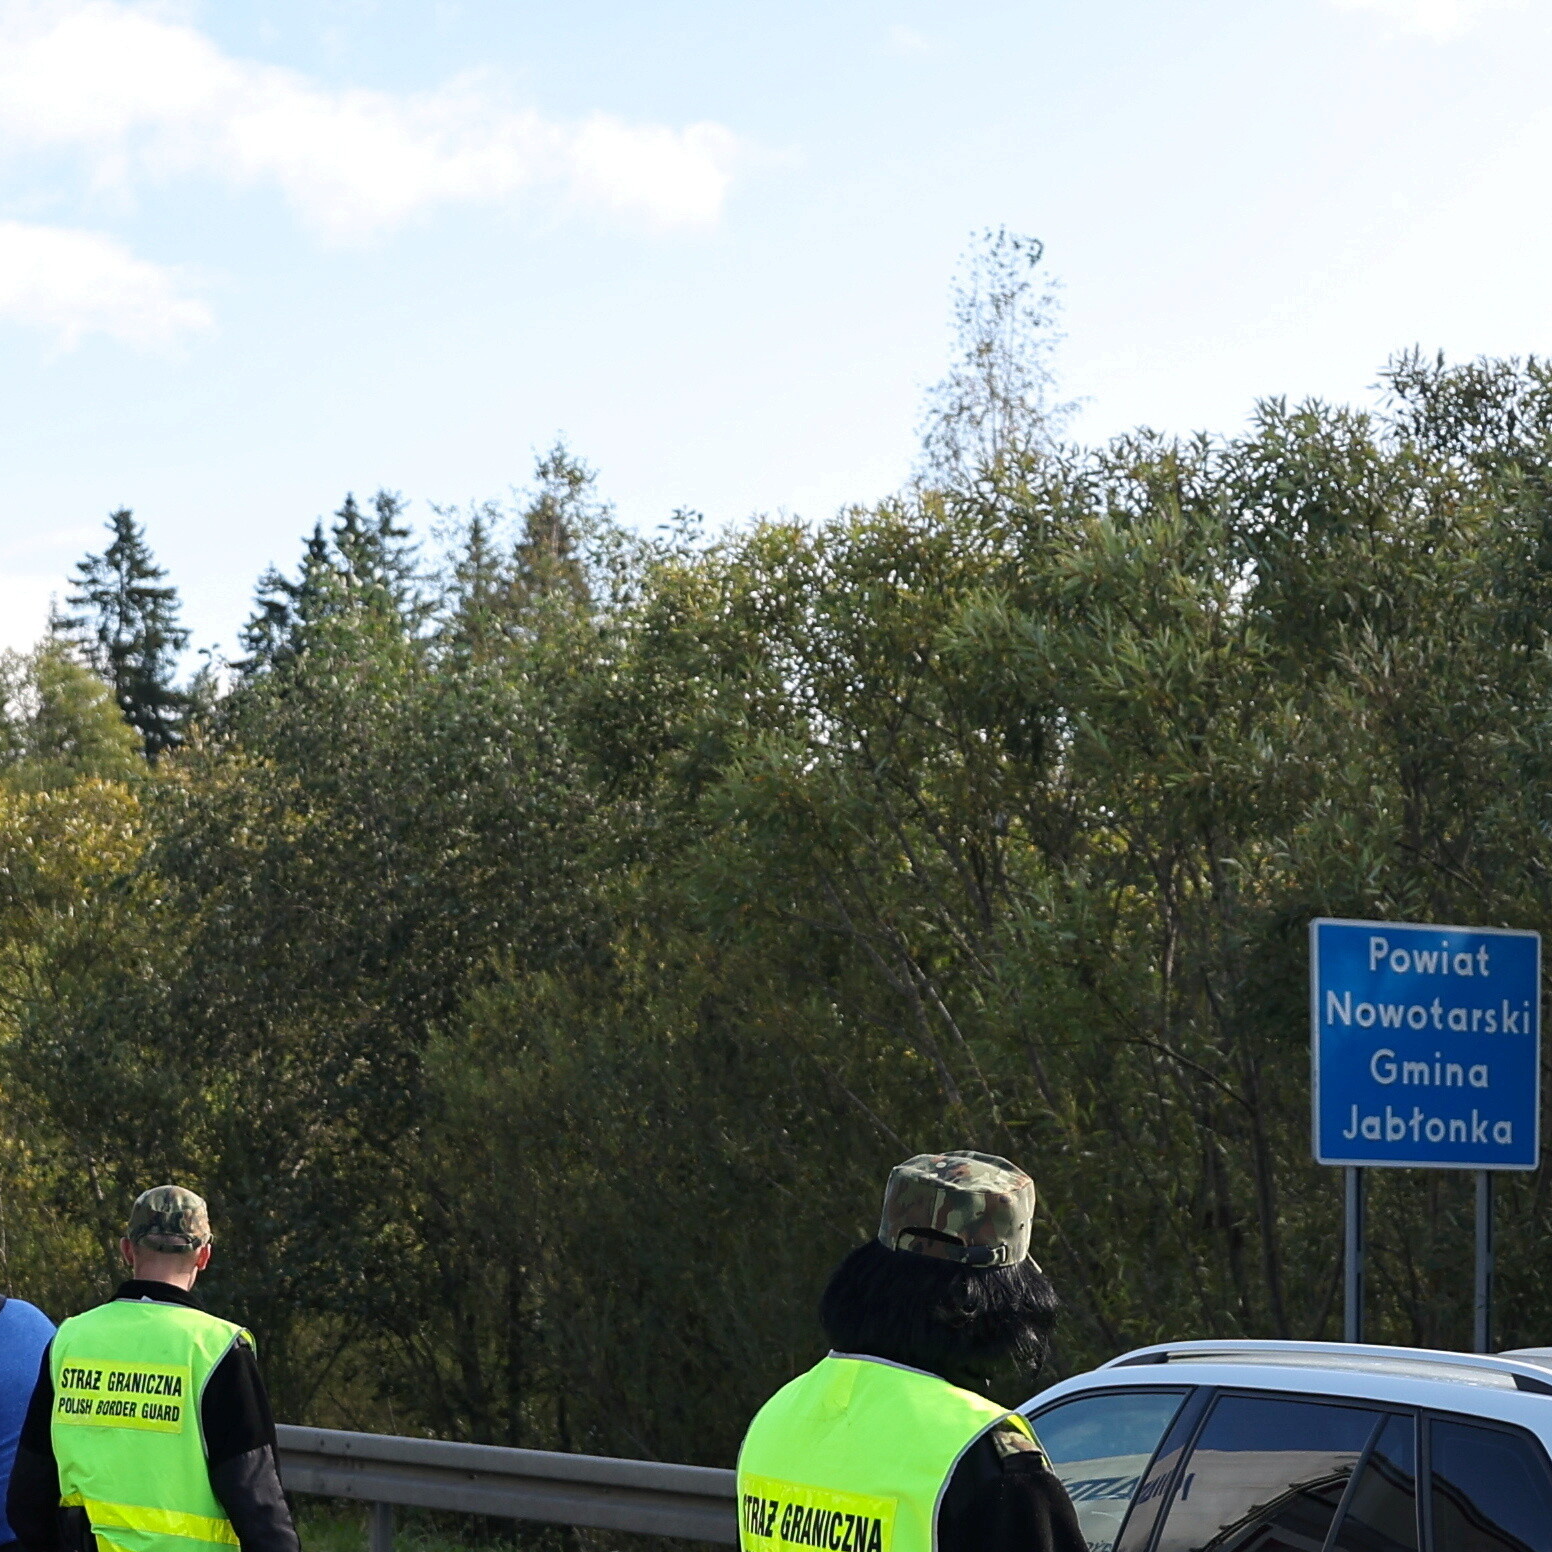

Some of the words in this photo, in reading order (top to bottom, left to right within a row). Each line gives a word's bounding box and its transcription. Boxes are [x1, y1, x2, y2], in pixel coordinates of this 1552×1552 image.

[1369, 937, 1490, 977] Powiat
[1326, 990, 1531, 1035] Nowotarski
[1370, 1049, 1489, 1088] Gmina
[1343, 1104, 1513, 1144] Jabłonka
[107, 1371, 182, 1397] GRANICZNA
[58, 1397, 93, 1415] POLISH
[96, 1399, 136, 1418] BORDER
[142, 1403, 180, 1422] GUARD
